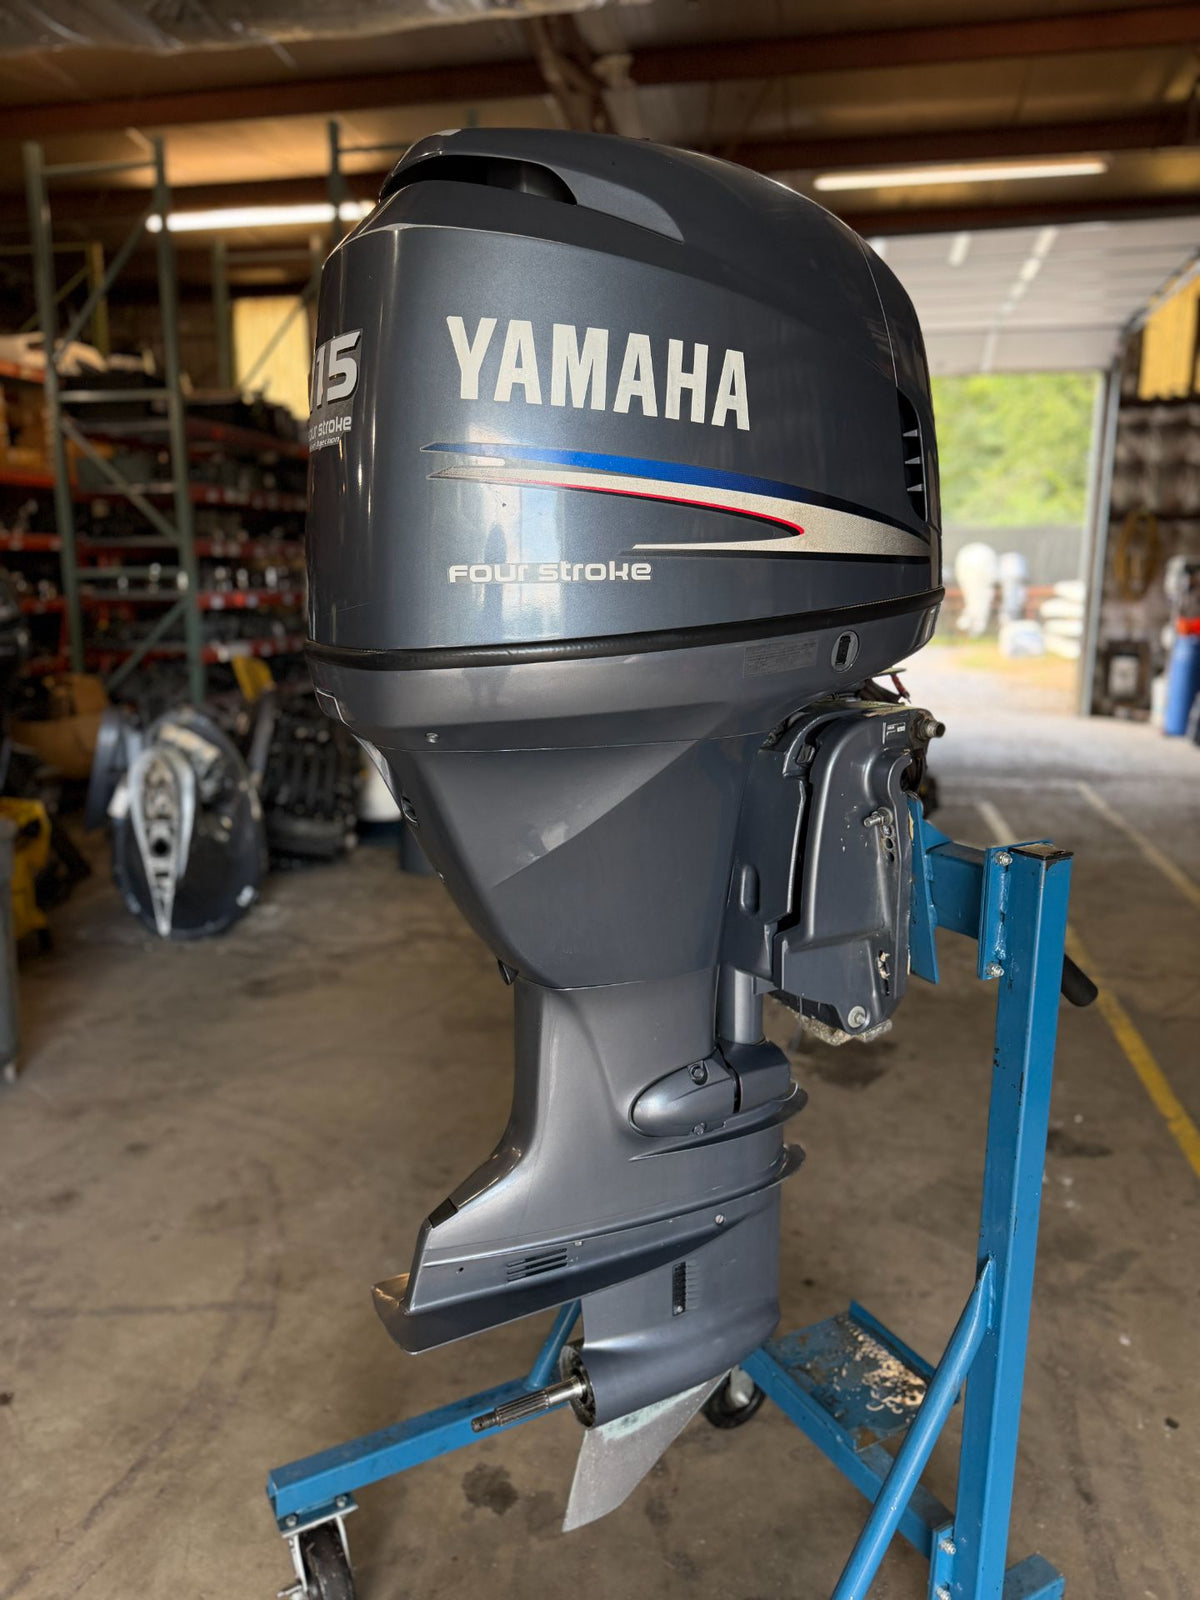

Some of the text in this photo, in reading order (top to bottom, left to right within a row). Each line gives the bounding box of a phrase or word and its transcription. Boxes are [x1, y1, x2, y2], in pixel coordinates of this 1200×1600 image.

[446, 316, 750, 431] YAMAHA
[318, 416, 352, 437] stroke
[538, 560, 651, 582] stroke
